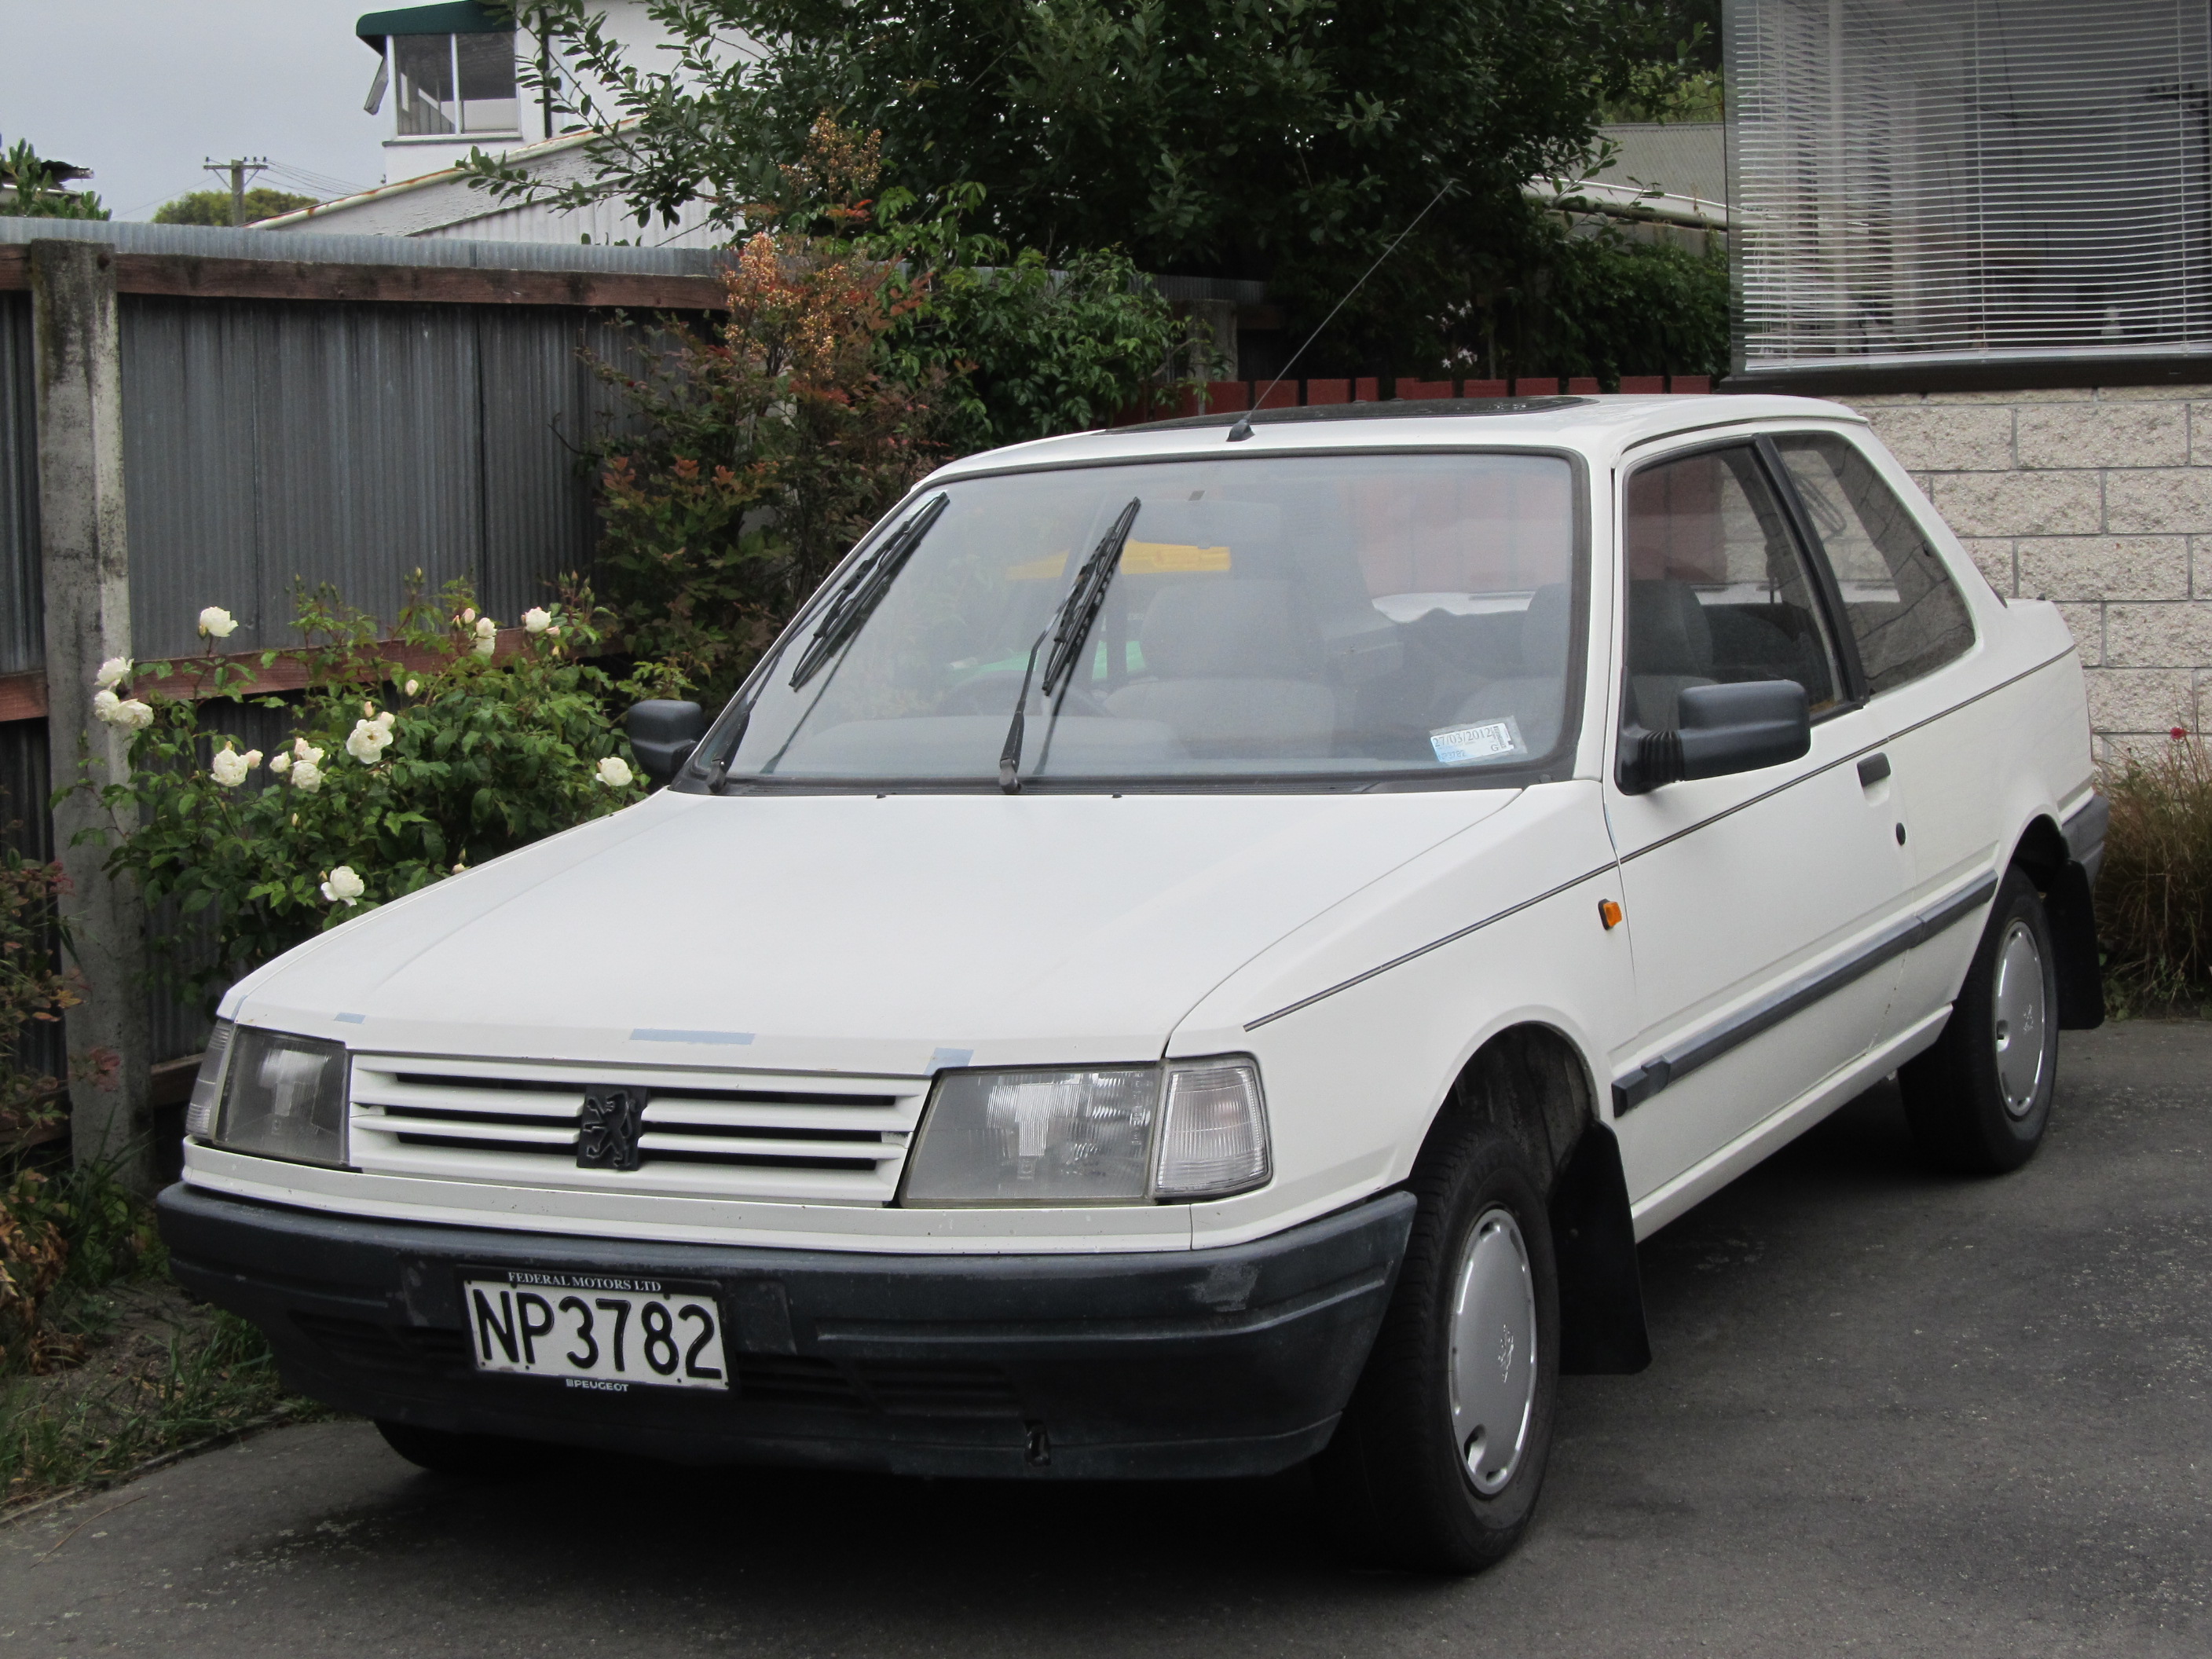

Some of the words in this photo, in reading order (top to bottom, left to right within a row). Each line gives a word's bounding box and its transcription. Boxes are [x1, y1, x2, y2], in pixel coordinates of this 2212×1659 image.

[1433, 727, 1492, 747] 27/03/2012
[507, 1271, 570, 1286] FEDERAL
[572, 1276, 632, 1291] MOTORS
[635, 1280, 661, 1291] LTD
[472, 1288, 723, 1379] NP3782
[573, 1379, 628, 1392] PEUGEOT
